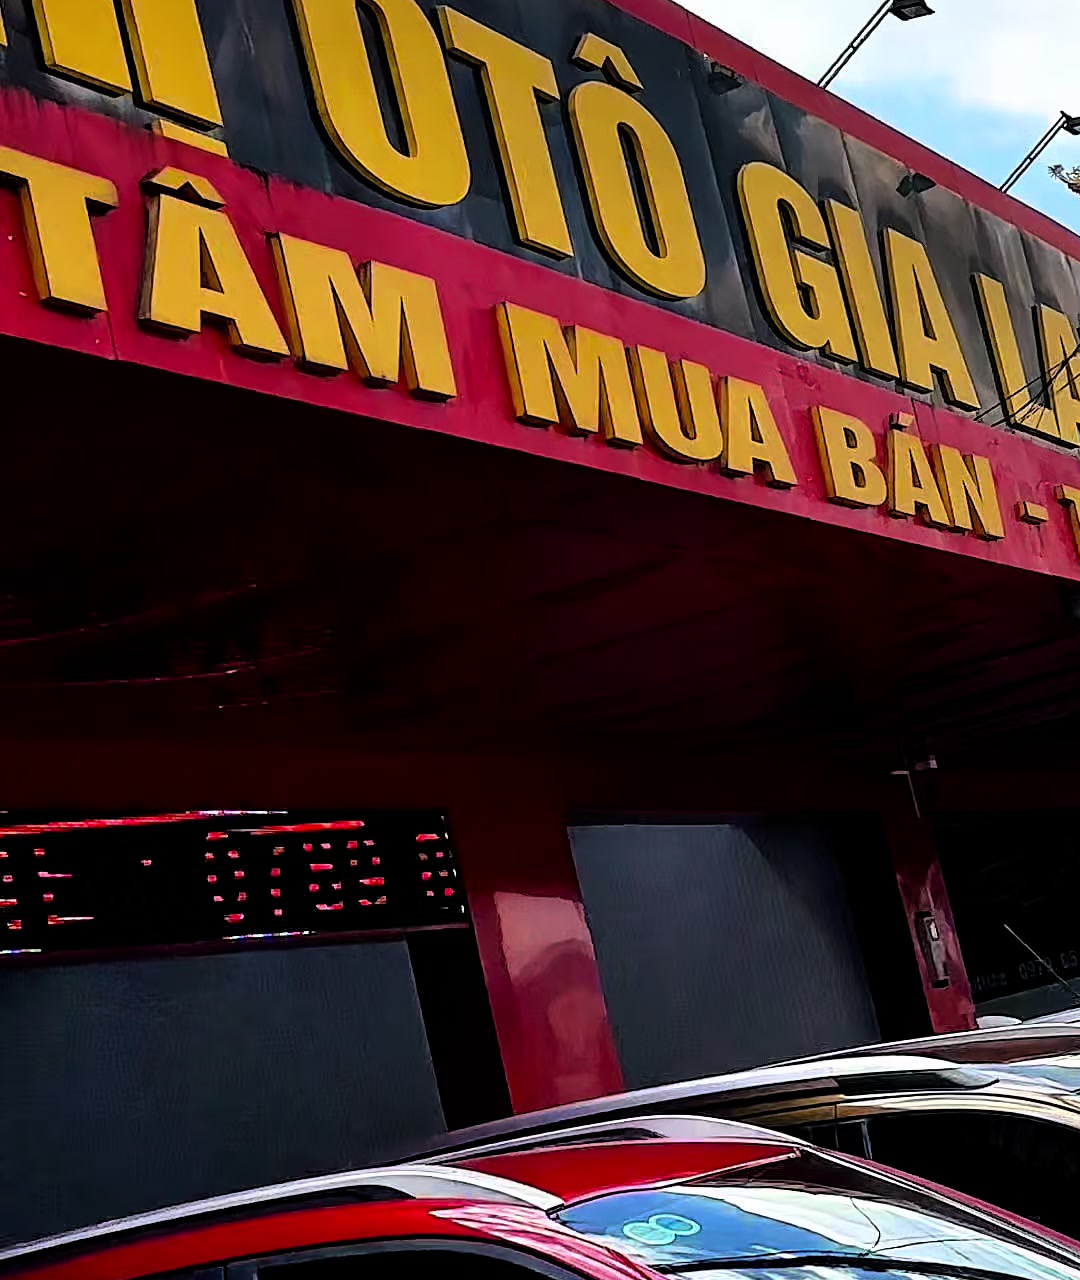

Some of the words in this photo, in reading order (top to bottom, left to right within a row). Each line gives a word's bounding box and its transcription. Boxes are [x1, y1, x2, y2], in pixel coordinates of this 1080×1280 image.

[0, 146, 457, 401] TÂM
[496, 301, 799, 488] MUA
[811, 405, 1006, 540] BÁN
[1019, 501, 1048, 523] -
[738, 161, 981, 410] GIA
